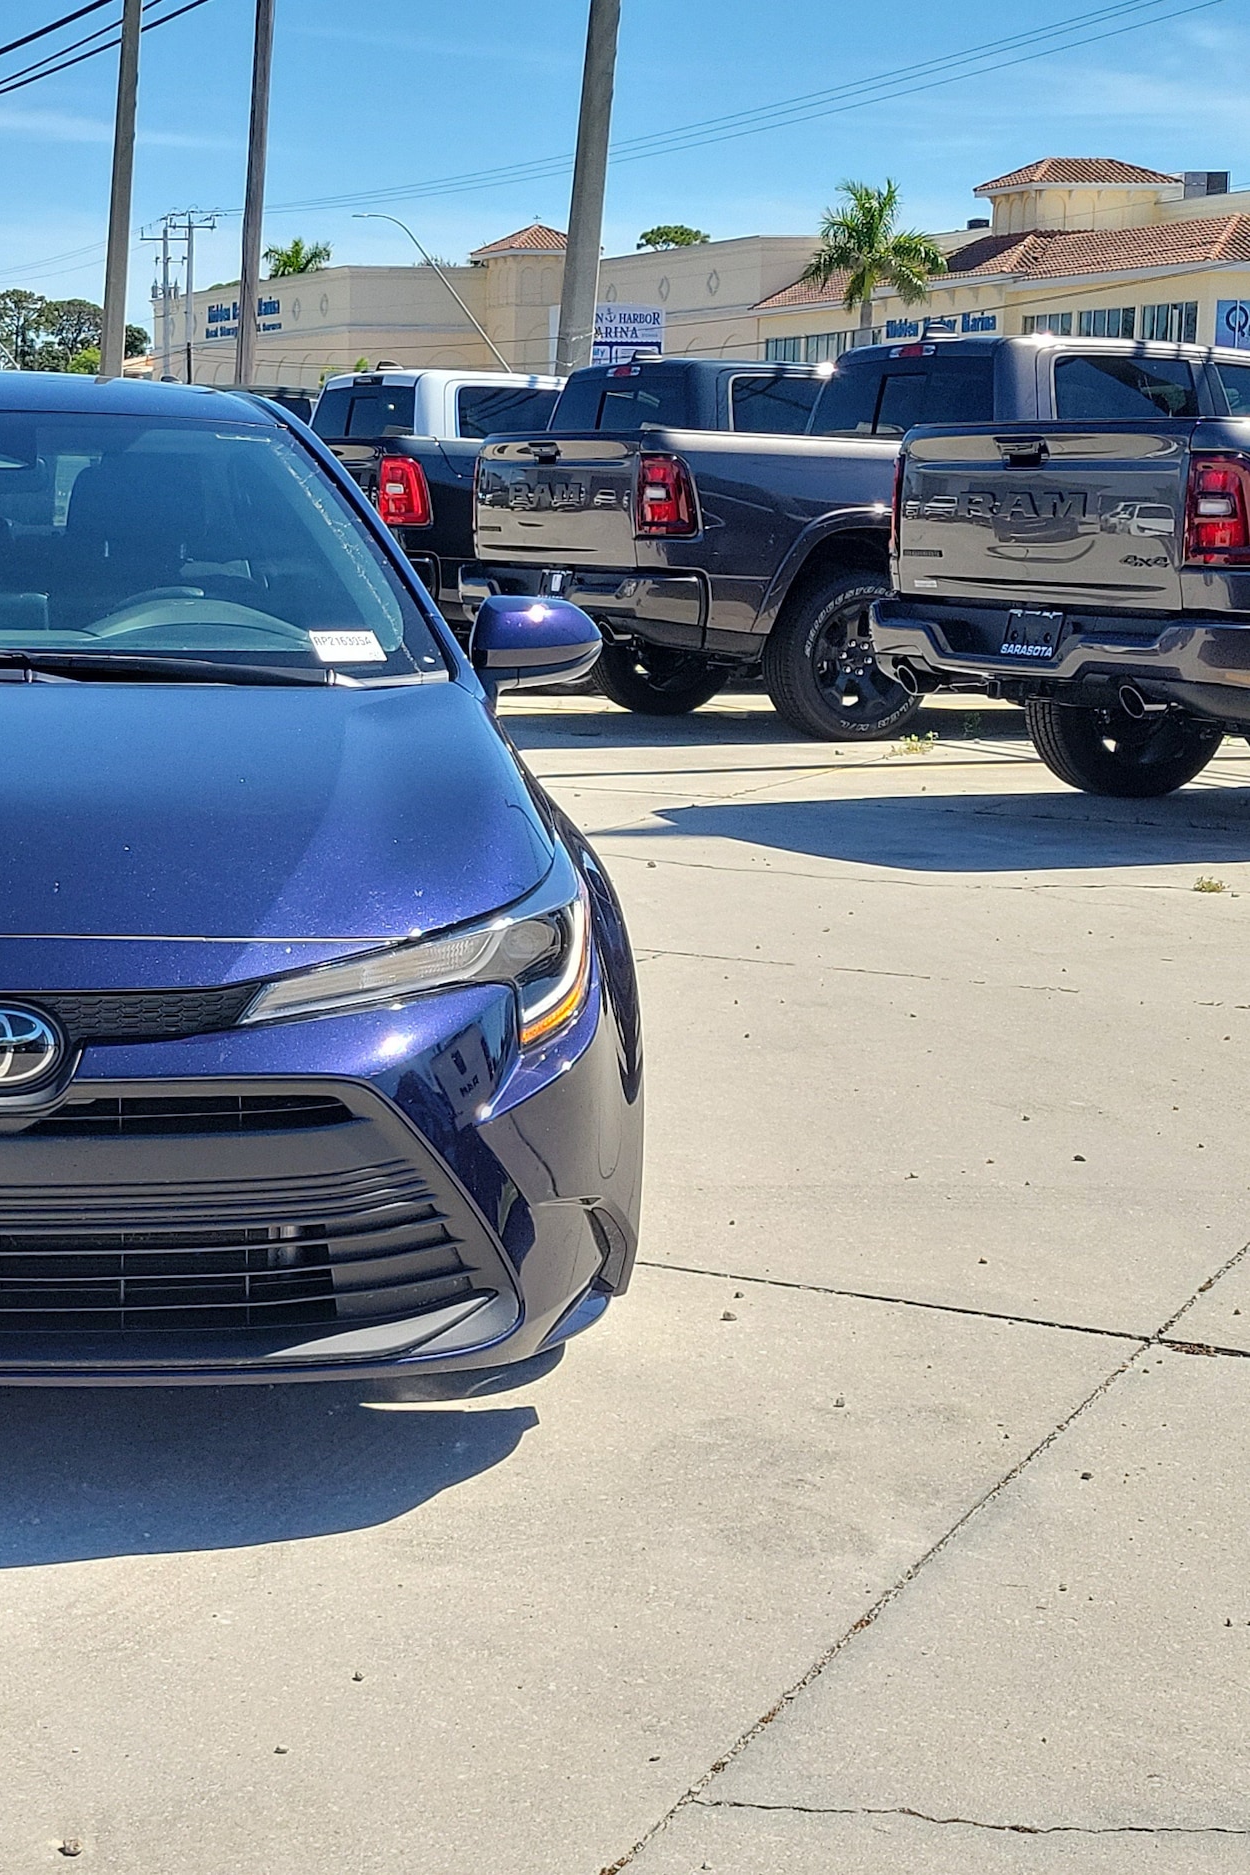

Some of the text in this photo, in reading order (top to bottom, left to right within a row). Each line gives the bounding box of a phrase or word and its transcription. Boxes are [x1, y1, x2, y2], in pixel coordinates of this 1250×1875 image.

[619, 312, 660, 325] HARBOR
[509, 483, 583, 506] RAM
[959, 491, 1088, 519] RAM
[1119, 554, 1169, 568] 4x4
[1000, 643, 1053, 657] SARASOTA
